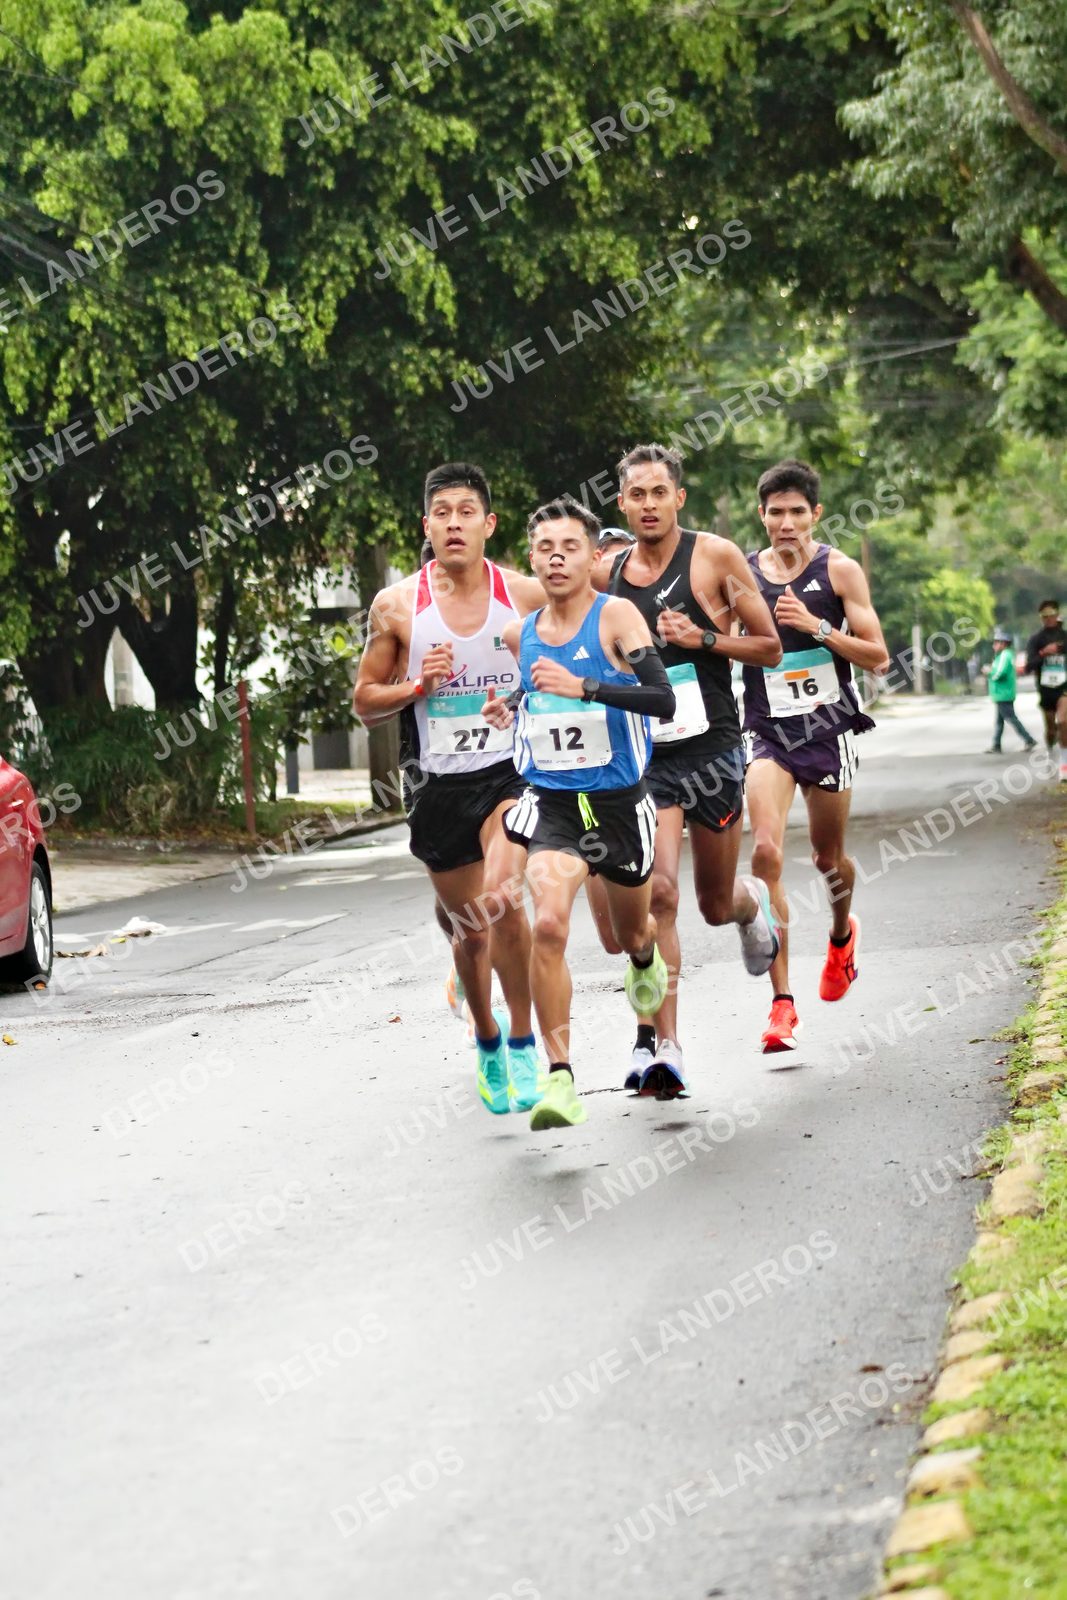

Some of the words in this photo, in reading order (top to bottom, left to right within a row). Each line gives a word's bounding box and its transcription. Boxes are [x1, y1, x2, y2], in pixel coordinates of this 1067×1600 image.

[787, 677, 819, 699] 16
[453, 728, 490, 752] 27
[549, 727, 585, 752] 12
